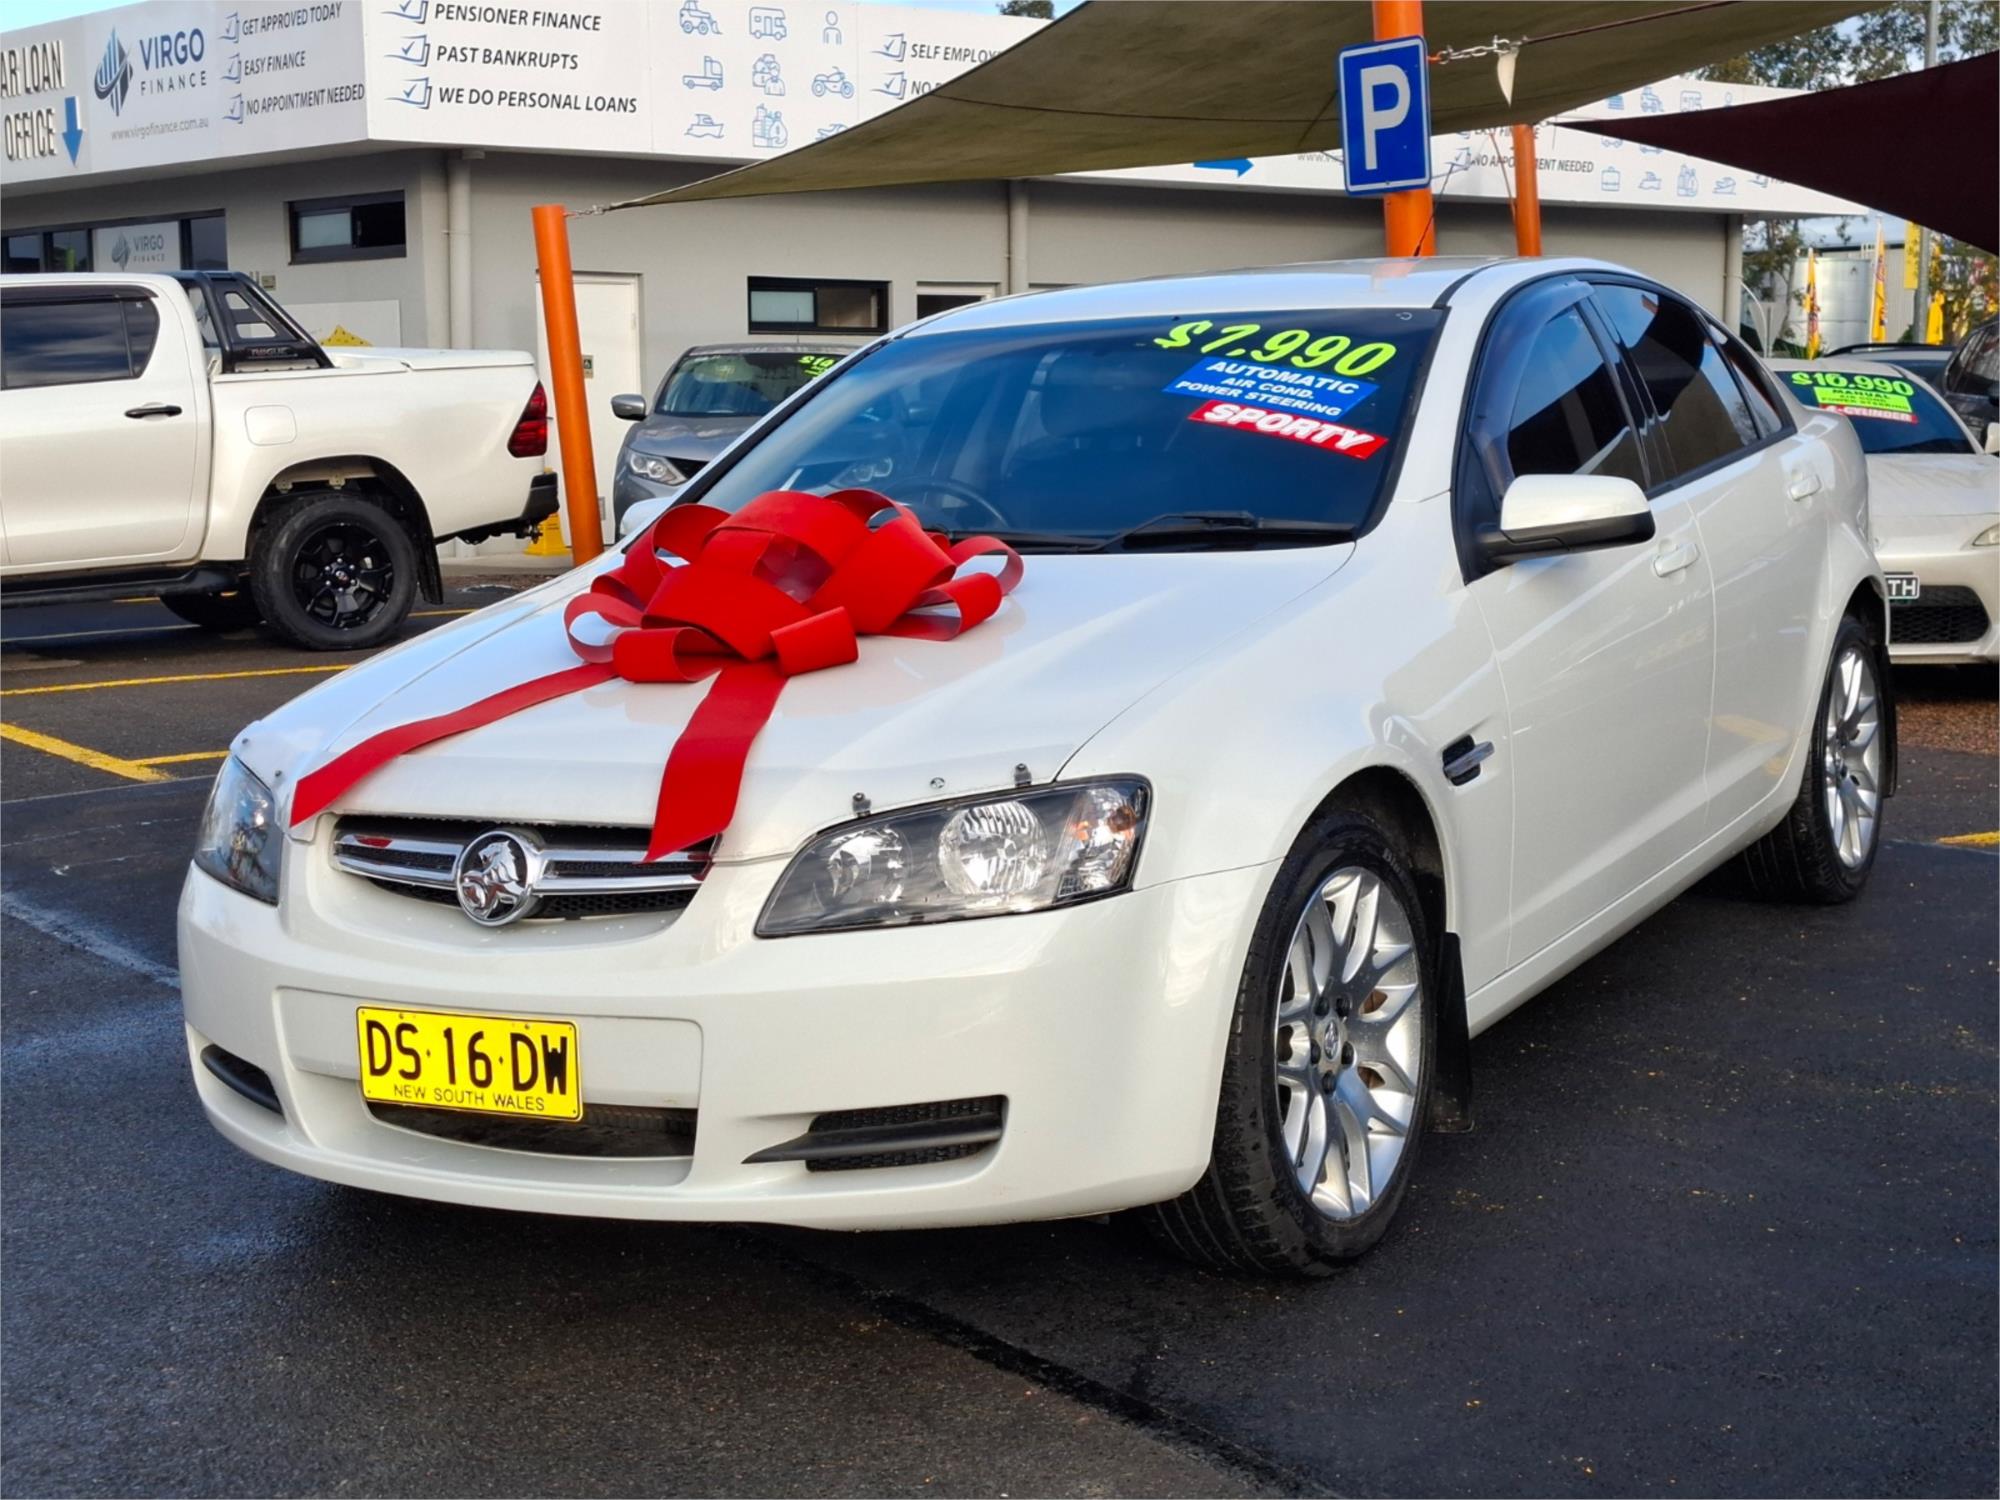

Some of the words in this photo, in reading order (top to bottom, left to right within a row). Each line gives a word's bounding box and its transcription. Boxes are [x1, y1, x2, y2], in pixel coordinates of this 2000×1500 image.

[242, 17, 258, 35] GET
[260, 9, 308, 31] APPROVED
[310, 2, 342, 23] TODAY
[434, 3, 528, 26] PENSIONER
[532, 11, 601, 31] FINANCE
[139, 28, 205, 71] VIRGO
[244, 58, 265, 76] EASY
[267, 50, 306, 72] FINANCE
[436, 45, 478, 64] PAST
[482, 49, 578, 70] BANKRUPTS
[911, 43, 941, 60] SELF
[23, 40, 64, 94] LOAN
[141, 70, 207, 96] FINANCE
[911, 80, 932, 95] NO
[246, 98, 259, 115] NO
[261, 88, 325, 113] APPOINTMENT
[327, 83, 365, 103] NEEDED
[439, 87, 464, 104] WE
[469, 89, 494, 105] DO
[498, 90, 581, 110] PERSONAL
[585, 96, 637, 113] LOANS
[1361, 64, 1411, 171] P
[5, 108, 56, 161] OFFICE
[1557, 158, 1594, 173] NEEDED
[133, 234, 164, 252] VIRGO
[1206, 361, 1360, 395] AUTOMATIC
[1221, 377, 1257, 389] AIR
[1259, 382, 1315, 400] COND.
[1175, 381, 1240, 398] POWER
[1244, 391, 1342, 417] STEERING
[1203, 403, 1375, 451] SPORTY
[394, 1084, 427, 1100] NEW
[434, 1088, 485, 1105] SOUTH
[494, 1093, 545, 1111] WALES
